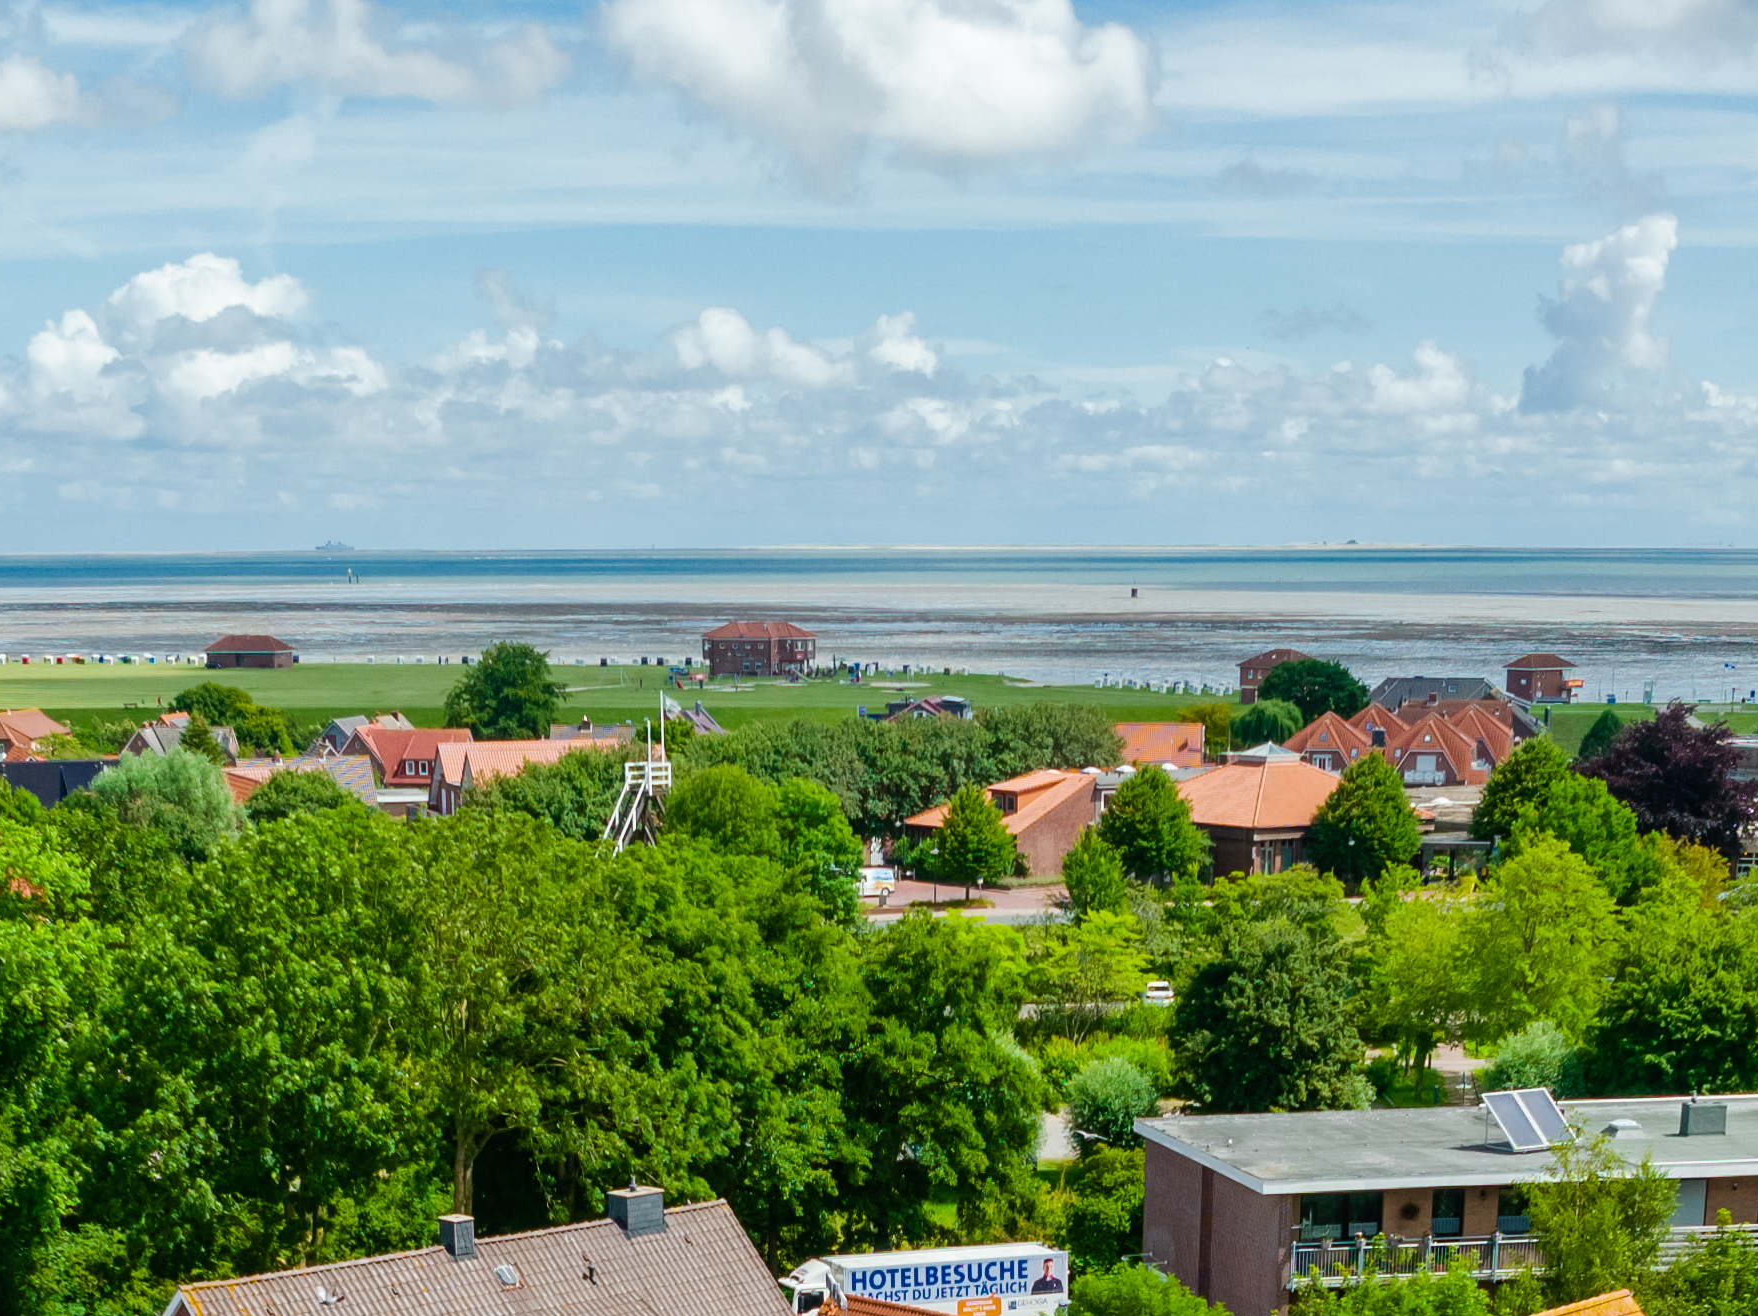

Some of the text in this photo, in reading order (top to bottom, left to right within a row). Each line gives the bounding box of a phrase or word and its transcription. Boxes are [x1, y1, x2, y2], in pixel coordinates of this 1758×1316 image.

[851, 1259, 1029, 1292] HOTELBESUCHE
[913, 1288, 932, 1301] DU
[935, 1285, 970, 1299] JETZT
[974, 1280, 1028, 1296] TÄGLICH
